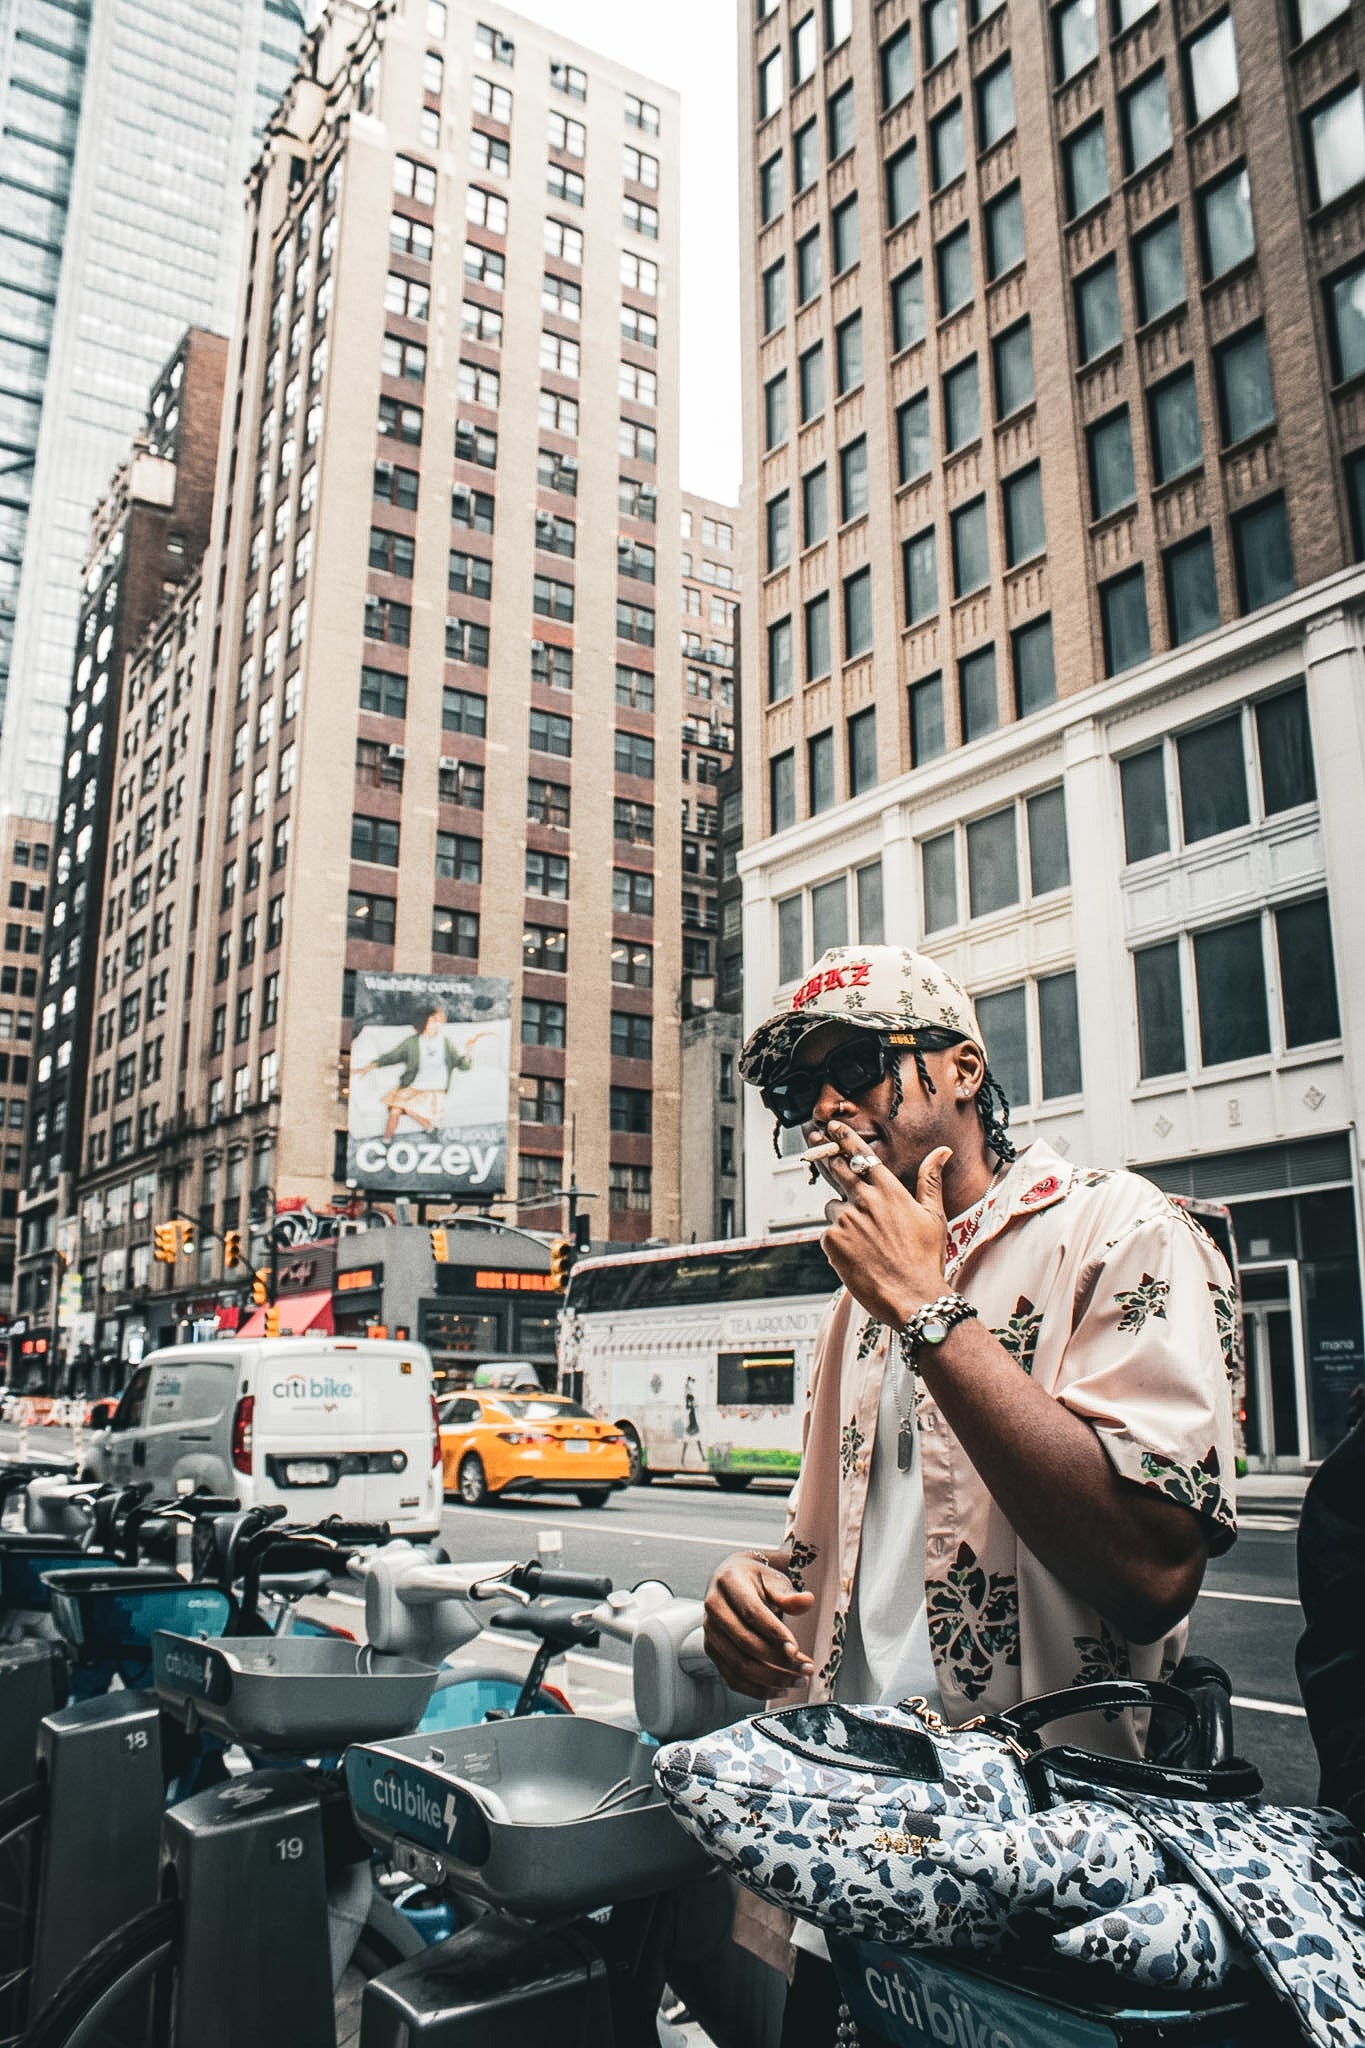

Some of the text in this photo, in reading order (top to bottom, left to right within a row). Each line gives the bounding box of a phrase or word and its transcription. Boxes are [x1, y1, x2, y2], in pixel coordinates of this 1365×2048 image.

[355, 1141, 499, 1184] cozey
[729, 1319, 752, 1334] TEA
[755, 1314, 808, 1334] AROUND
[272, 1376, 353, 1398] citi bike
[124, 1731, 148, 1750] 18
[373, 1776, 442, 1829] citi bike
[276, 1837, 304, 1861] 19
[865, 1967, 924, 2031] citi
